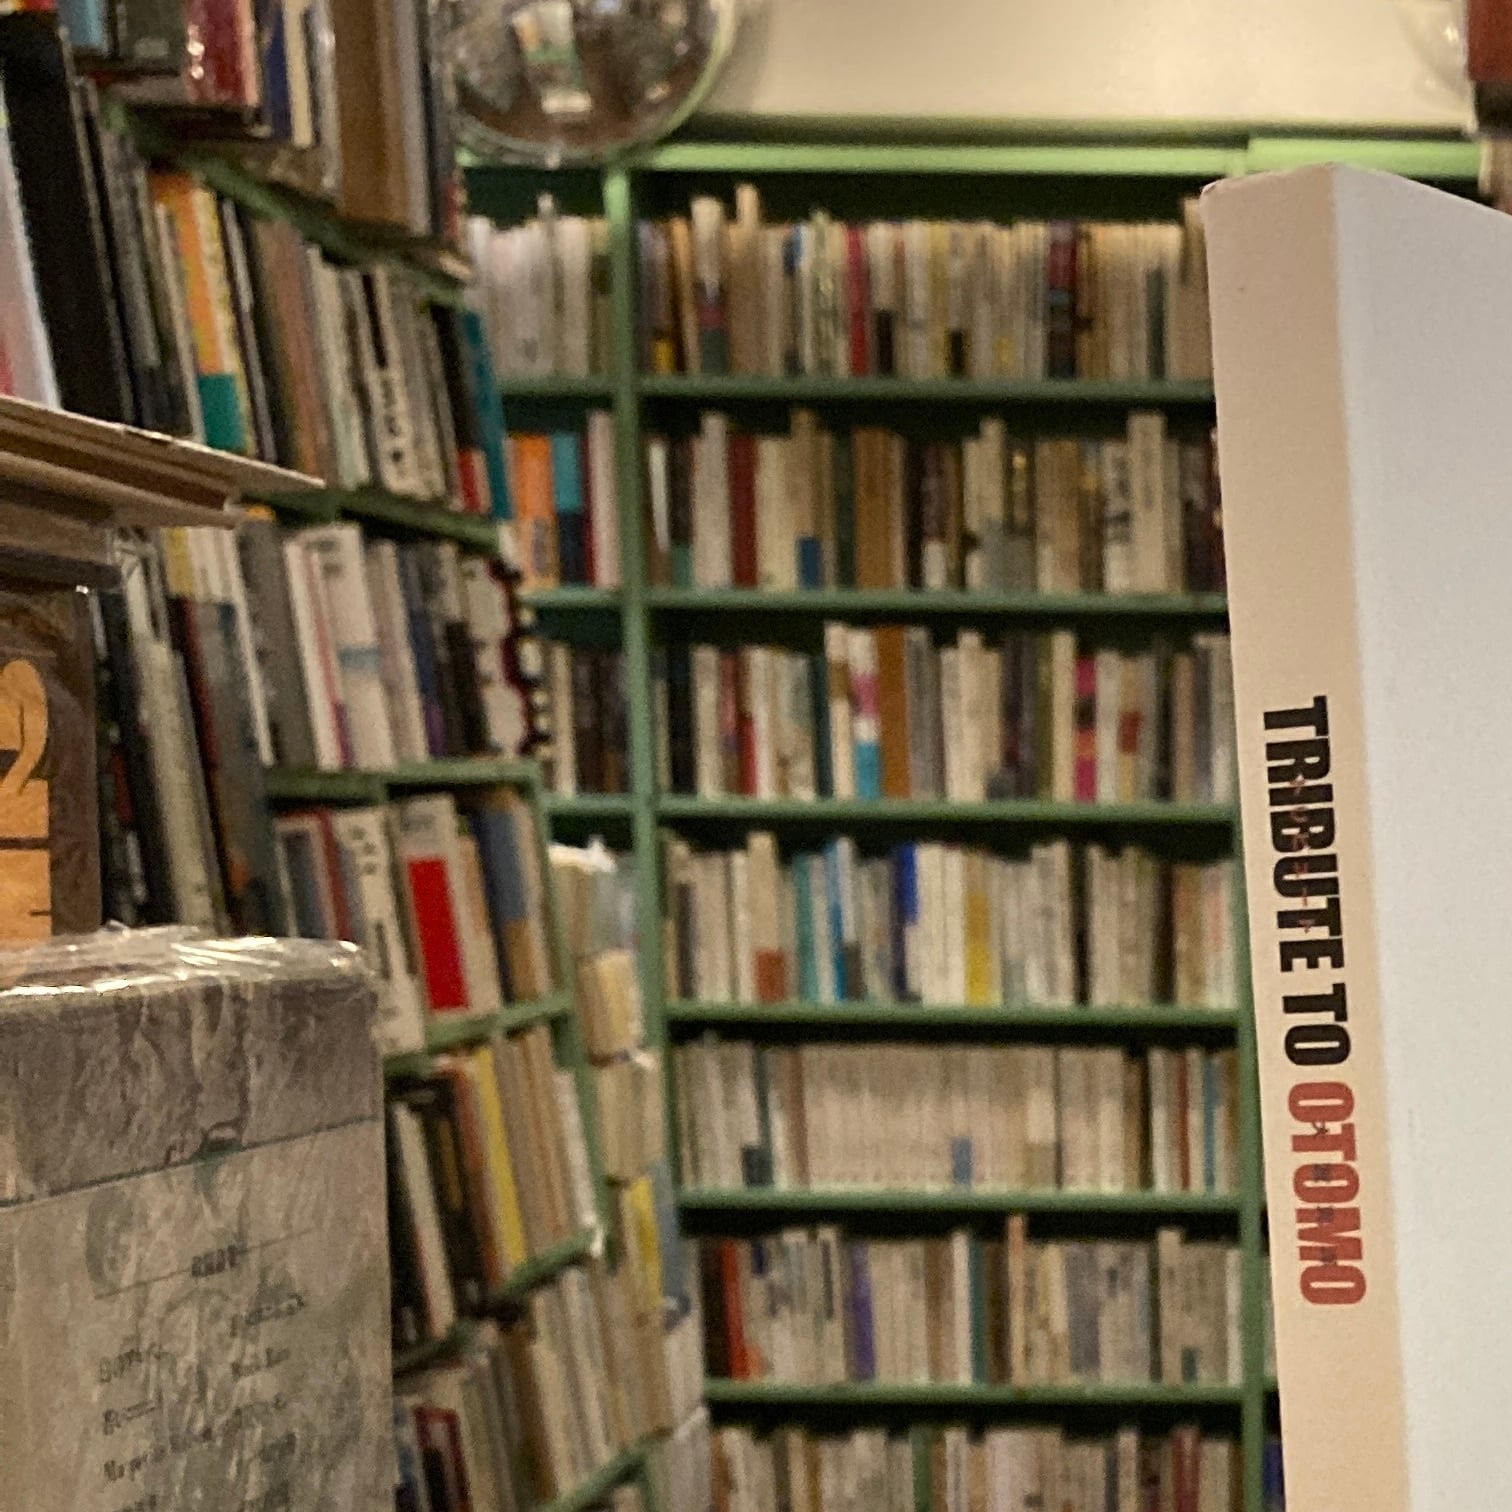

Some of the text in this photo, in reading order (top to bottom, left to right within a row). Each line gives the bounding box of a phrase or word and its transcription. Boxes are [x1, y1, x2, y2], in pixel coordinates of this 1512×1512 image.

[1263, 695, 1367, 1305] TRIBUTE TO OTOMO
